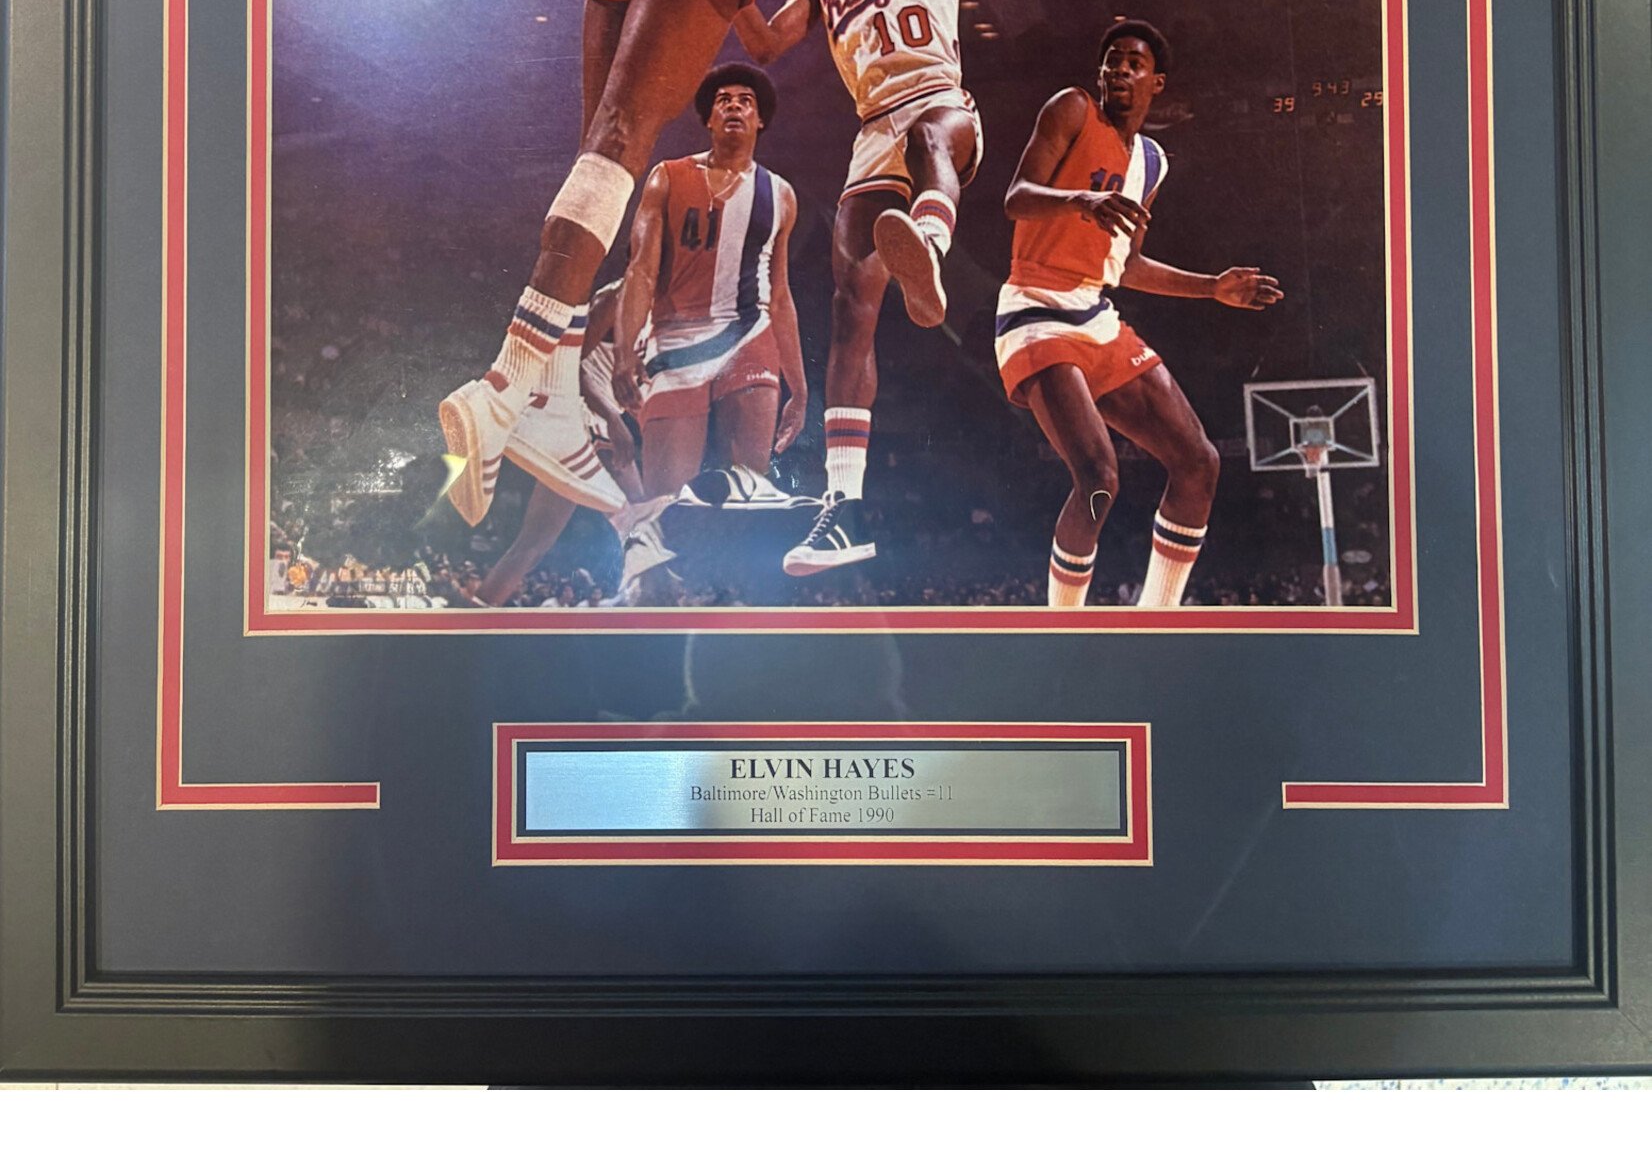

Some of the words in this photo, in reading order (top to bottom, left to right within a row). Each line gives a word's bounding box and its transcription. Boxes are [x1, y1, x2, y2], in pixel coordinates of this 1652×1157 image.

[873, 4, 933, 56] 10
[1273, 97, 1295, 112] 39
[680, 207, 720, 252] 41
[729, 758, 814, 780] ELVIN
[822, 758, 916, 779] HAYES
[691, 785, 863, 804] Baltimore/Washington
[868, 785, 922, 800] Bullets
[751, 807, 783, 823] Hall
[788, 807, 806, 823] of
[809, 807, 851, 823] Fame
[858, 807, 895, 823] 1990
